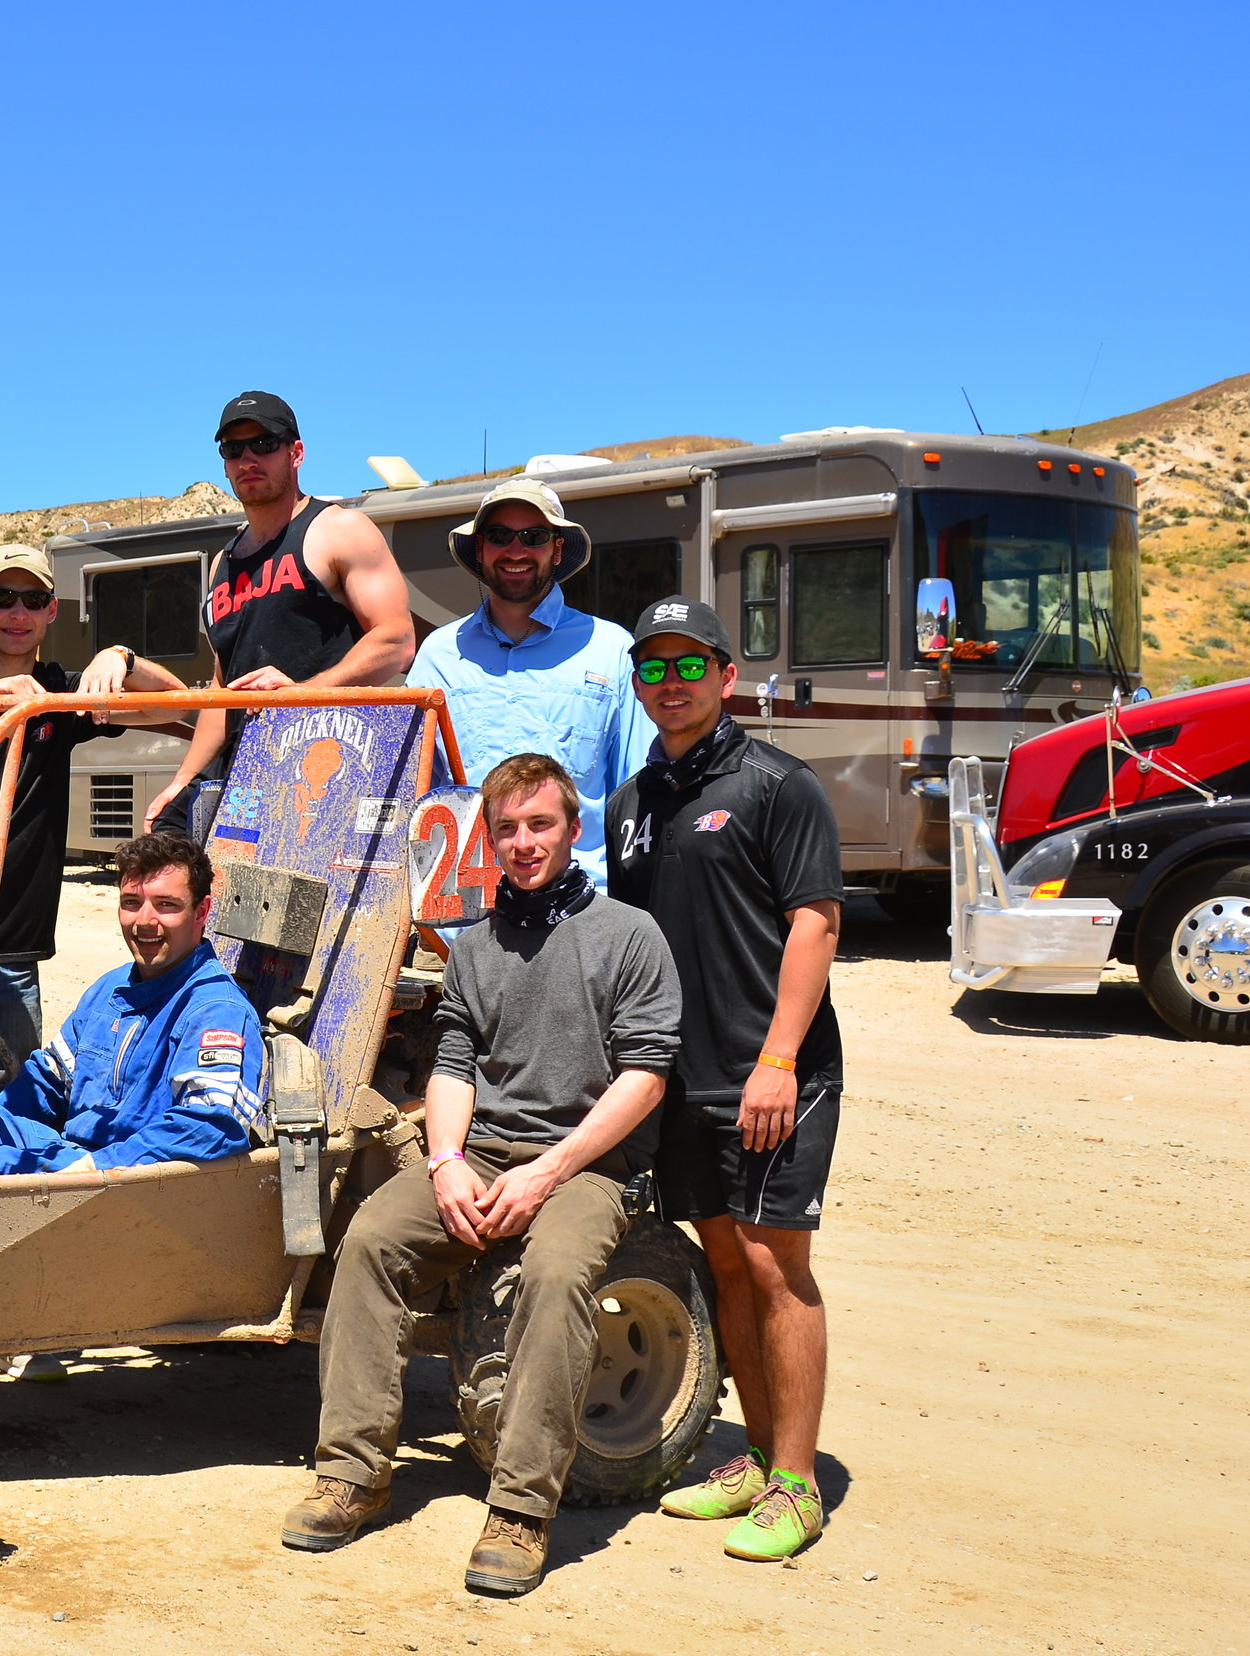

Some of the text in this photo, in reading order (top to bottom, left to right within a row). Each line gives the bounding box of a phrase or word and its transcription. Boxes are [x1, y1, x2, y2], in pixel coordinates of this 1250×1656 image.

[653, 603, 690, 620] SAE
[620, 812, 653, 861] 24
[1094, 843, 1149, 860] 1182
[418, 803, 503, 919] 24
[206, 1034, 238, 1043] SIMPSON
